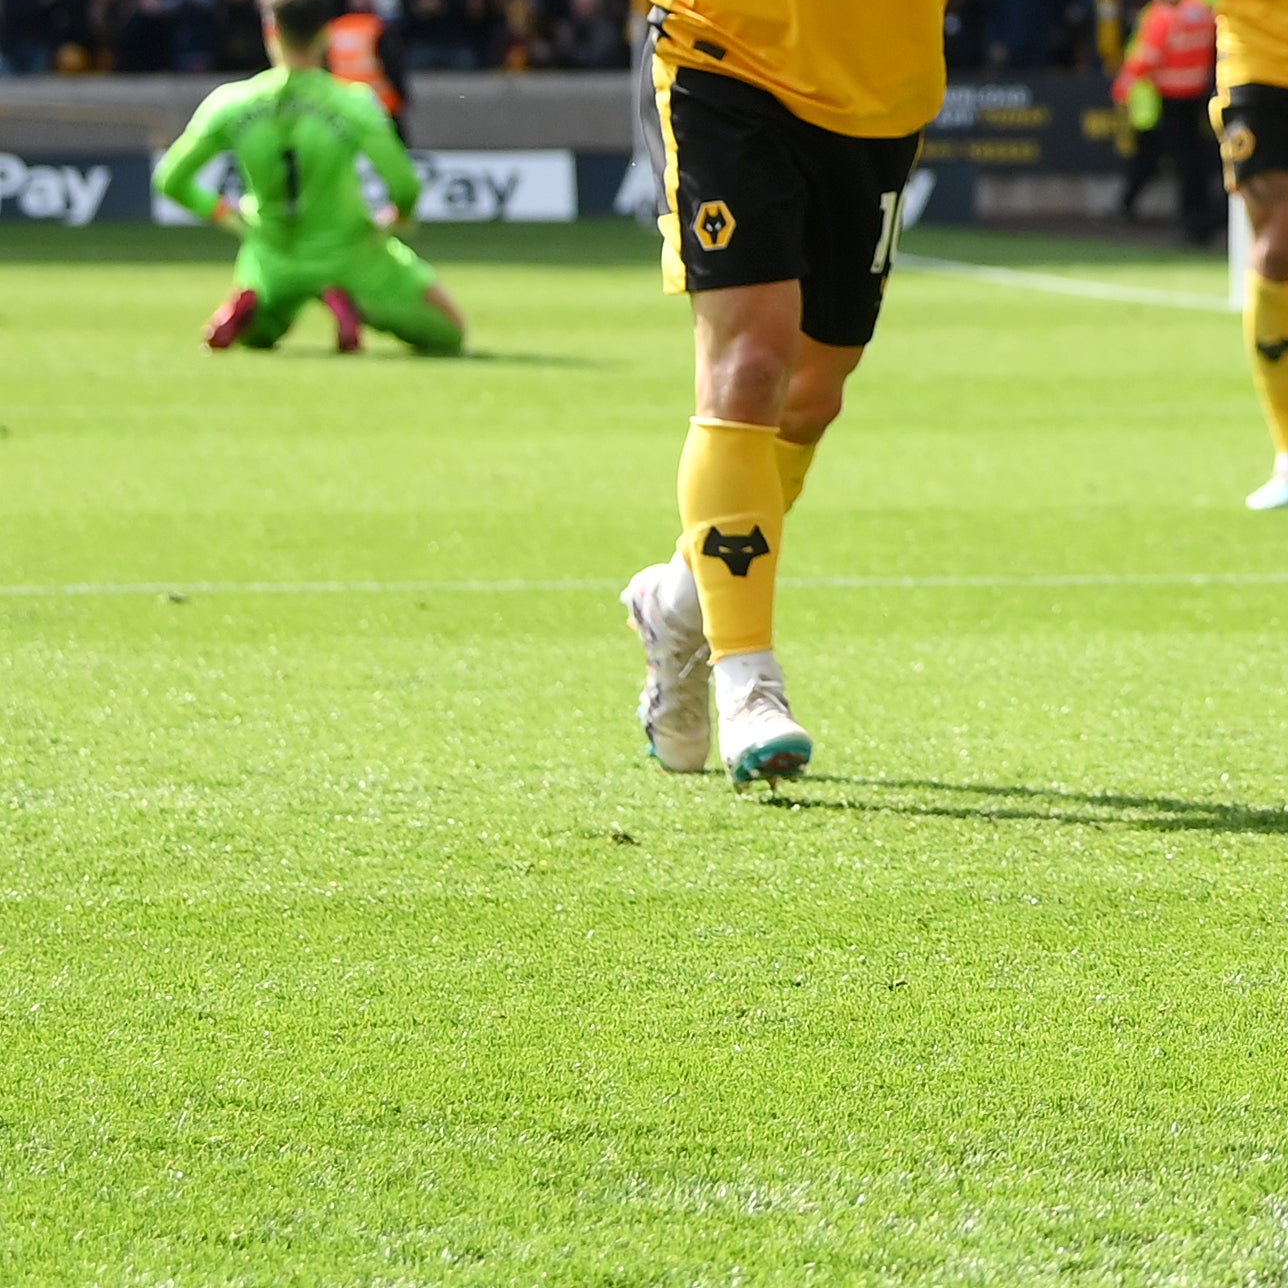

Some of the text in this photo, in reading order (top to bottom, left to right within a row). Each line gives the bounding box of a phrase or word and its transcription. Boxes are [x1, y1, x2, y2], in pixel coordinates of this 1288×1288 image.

[0, 152, 111, 226] Pay
[281, 146, 299, 218] 1
[870, 191, 904, 274] 1
